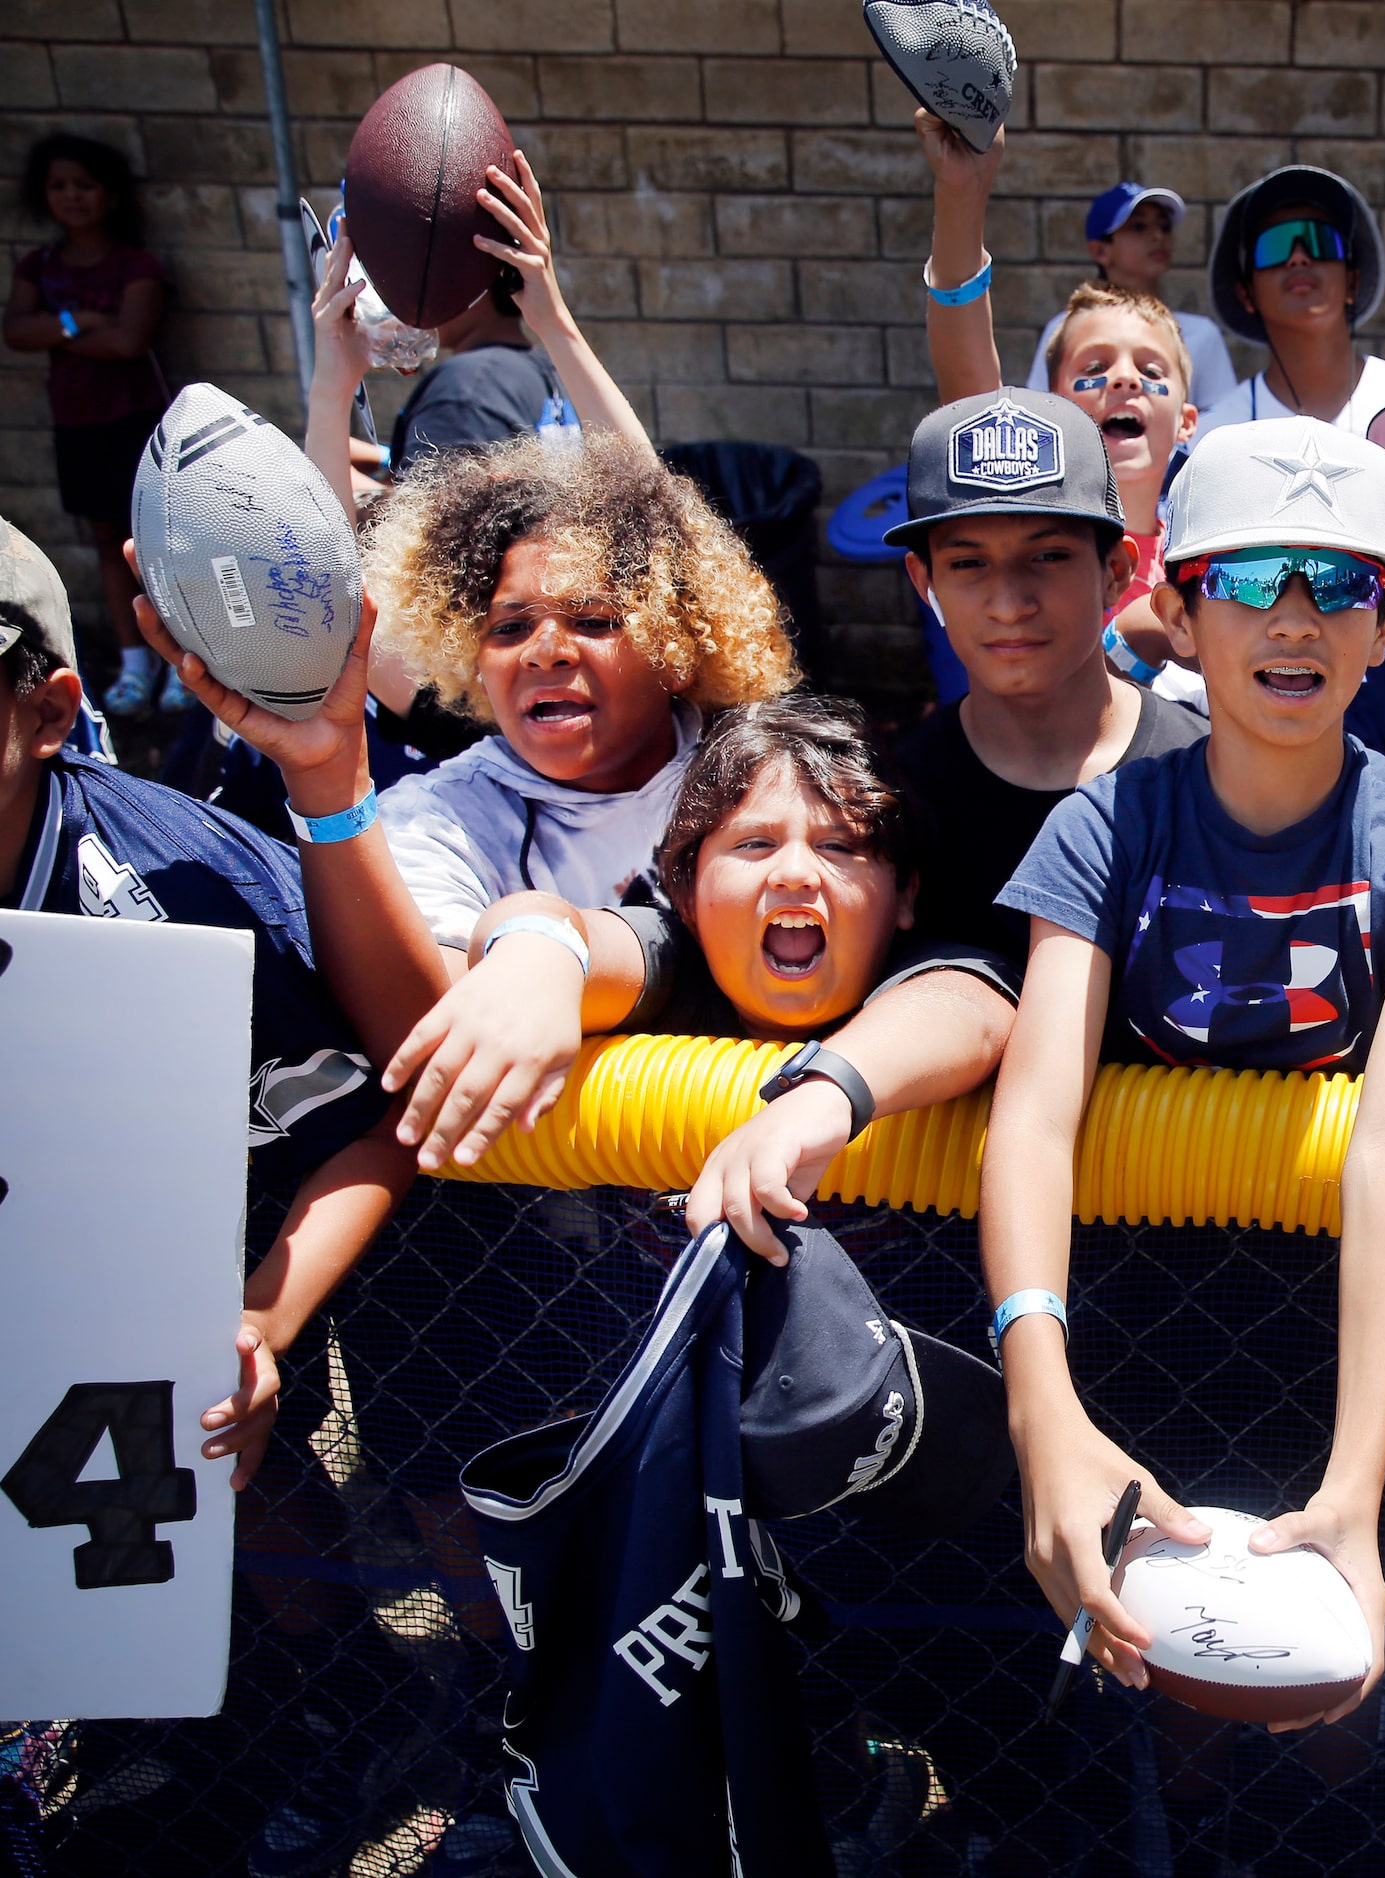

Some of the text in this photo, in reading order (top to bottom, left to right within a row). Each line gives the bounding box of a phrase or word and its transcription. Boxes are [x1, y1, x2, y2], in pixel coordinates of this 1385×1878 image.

[961, 82, 1000, 124] CREW
[971, 426, 1039, 462] DALLAS
[980, 459, 1032, 476] COWBOYS
[0, 1380, 197, 1591] 4
